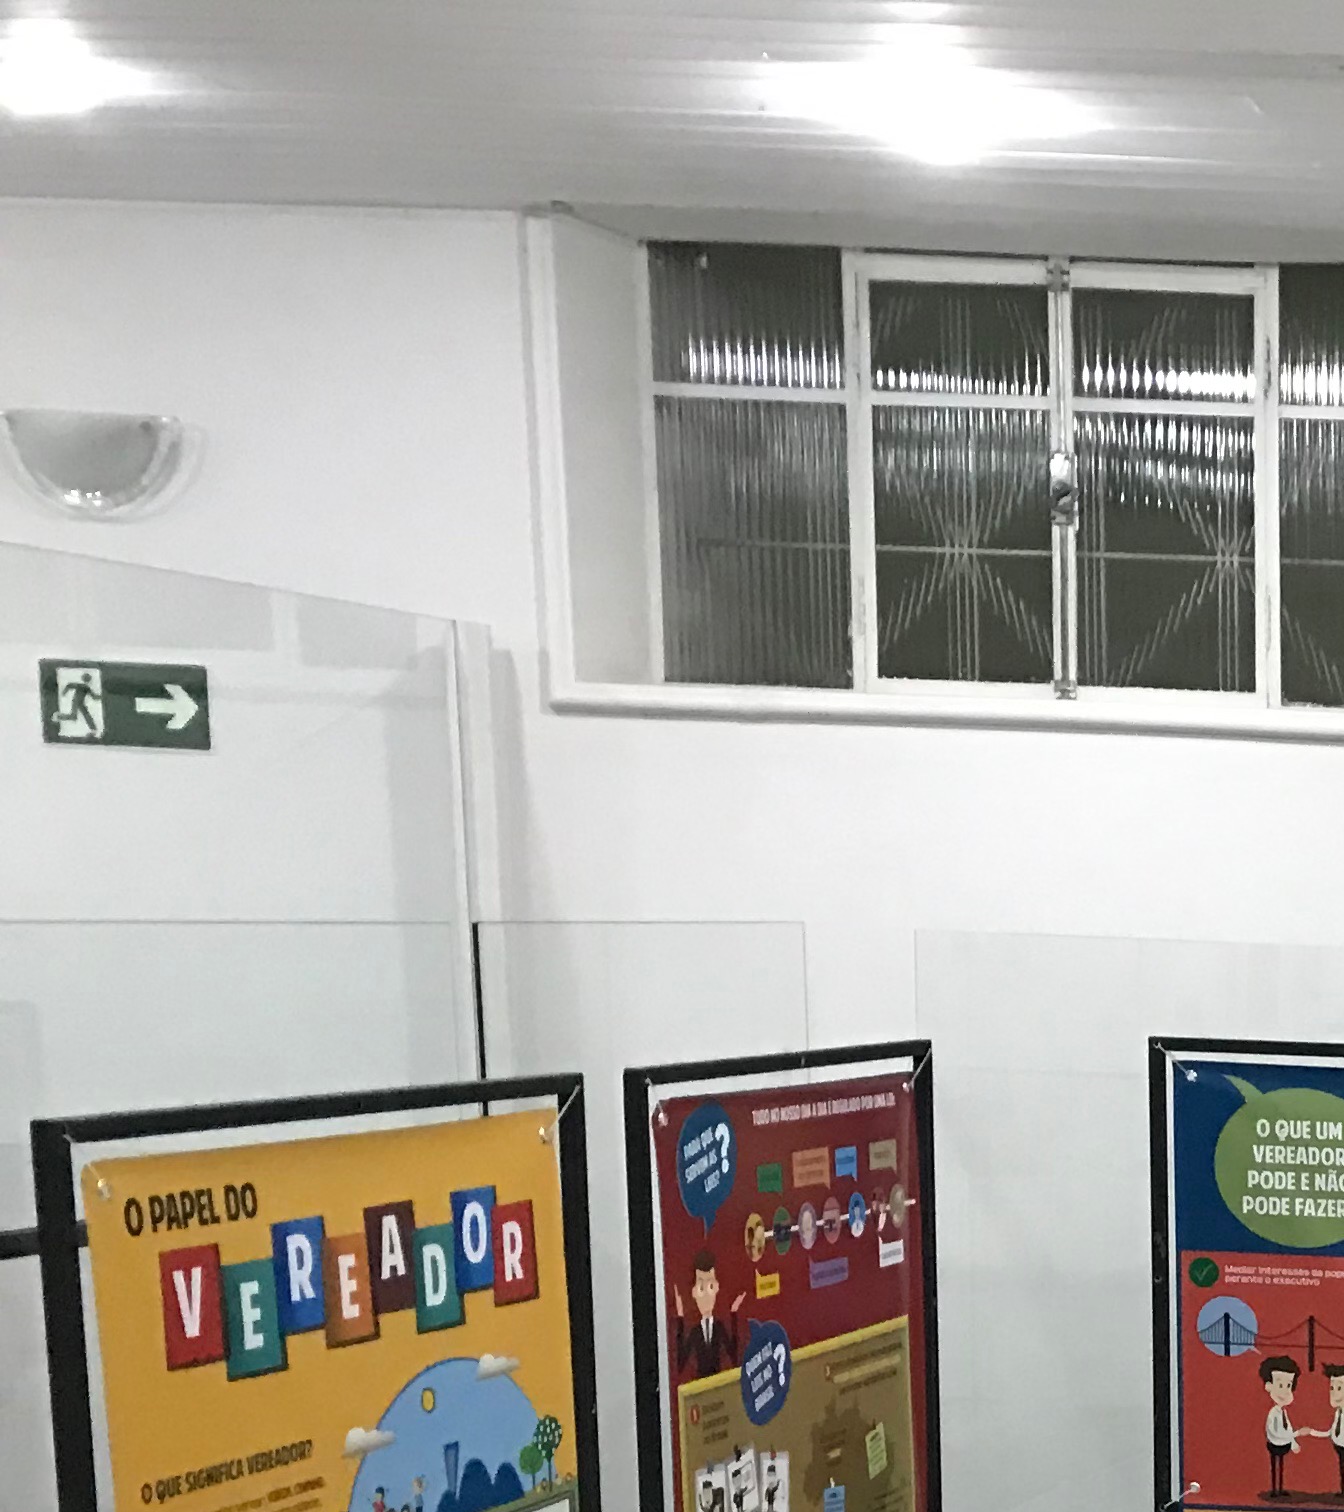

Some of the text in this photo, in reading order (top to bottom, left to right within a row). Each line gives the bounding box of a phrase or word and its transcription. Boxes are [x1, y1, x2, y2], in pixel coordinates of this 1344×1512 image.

[1256, 1118, 1343, 1141] O QUE UM
[1247, 1170, 1296, 1191] PODE
[1301, 1173, 1310, 1191] E
[124, 1182, 258, 1236] O PAPEL DO
[1242, 1195, 1290, 1217] PODE
[172, 1200, 524, 1351] VEREADOR
[141, 1438, 313, 1505] O QUE SIGNIFICA VEREADOR?
